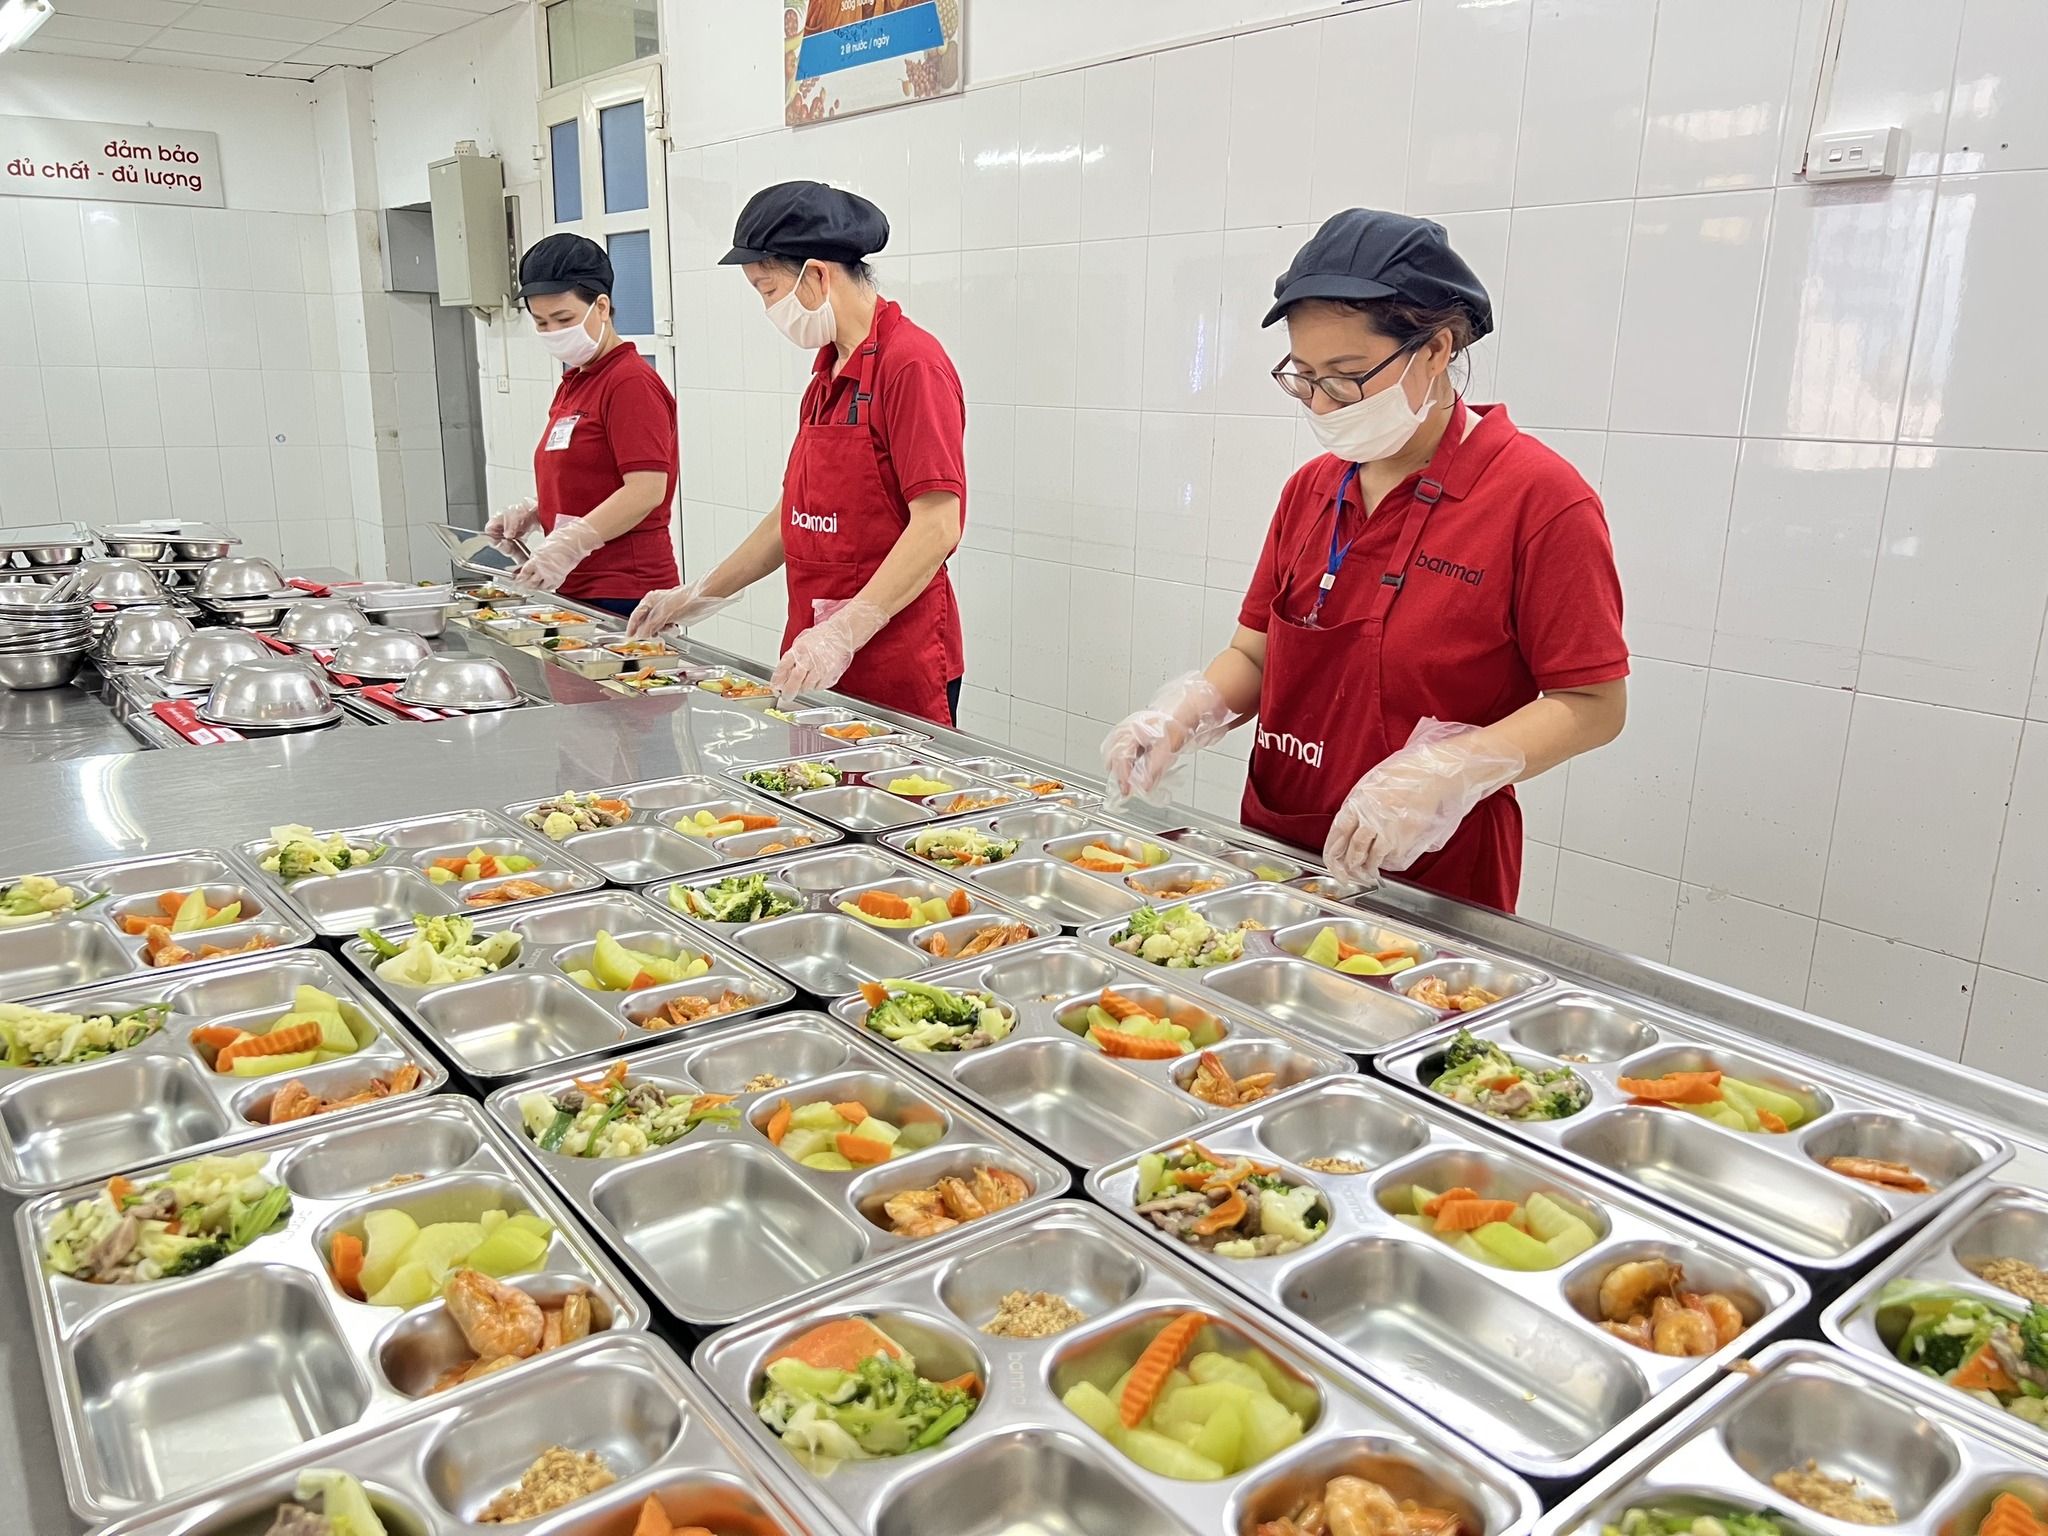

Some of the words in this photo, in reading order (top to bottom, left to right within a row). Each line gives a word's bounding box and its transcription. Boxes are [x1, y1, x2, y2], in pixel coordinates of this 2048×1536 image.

[873, 34, 890, 48] ngày
[104, 140, 152, 160] đảm
[158, 144, 199, 164] bảo
[7, 158, 35, 177] đủ
[41, 160, 90, 180] chất
[112, 165, 139, 183] đủ
[144, 168, 202, 192] lượng
[791, 505, 838, 534] bamai
[1415, 549, 1486, 587] banmai
[1257, 722, 1325, 769] nmai
